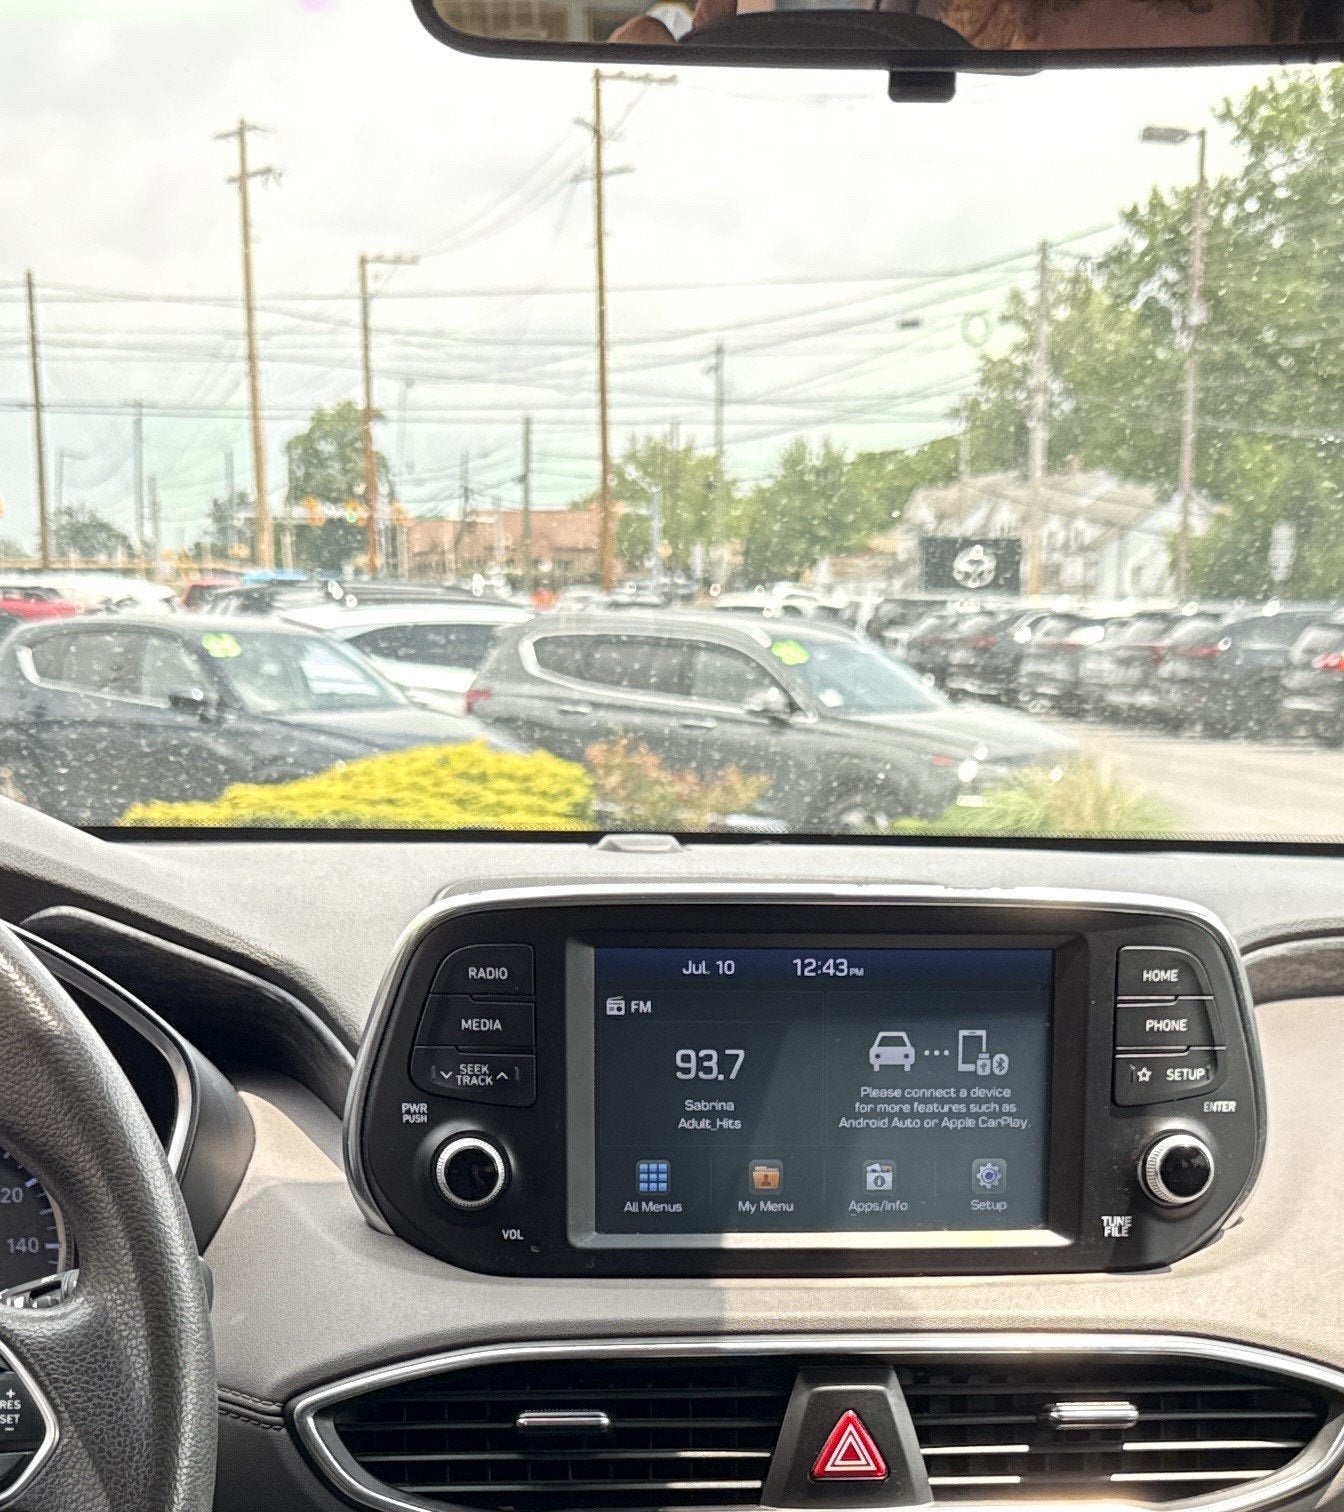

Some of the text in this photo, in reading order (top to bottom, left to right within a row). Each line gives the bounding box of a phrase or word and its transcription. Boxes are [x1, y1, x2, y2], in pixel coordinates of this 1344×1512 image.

[468, 967, 509, 980] RADIO
[716, 960, 736, 975] 10
[1143, 969, 1179, 982] HOME
[630, 1000, 652, 1014] FM
[461, 1019, 503, 1031] MEDIA
[1145, 1018, 1188, 1032] PHONE
[459, 1063, 490, 1075] SEEK
[675, 1049, 746, 1081] 93.7
[456, 1075, 494, 1086] TRACK
[1165, 1068, 1206, 1081] SETUP
[860, 1086, 1012, 1098] Please connect a device
[401, 1103, 429, 1114] PWR
[684, 1099, 735, 1112] Sabrina
[855, 1101, 1017, 1113] for more features such as
[1203, 1101, 1237, 1113] ENTER
[402, 1114, 428, 1123] PUSH
[678, 1117, 743, 1131] Adult_Hits
[839, 1117, 889, 1128] Android
[891, 1117, 920, 1128] Auto
[923, 1119, 939, 1128] or
[941, 1117, 976, 1130] Apple
[623, 1201, 683, 1213] All Menus
[738, 1201, 794, 1215] My Menu
[848, 1200, 909, 1214] Apps/Info
[971, 1199, 1008, 1214] Setup
[1100, 1215, 1133, 1227] TUNE
[501, 1229, 525, 1240] VOL
[1103, 1226, 1130, 1238] FILE
[7, 1237, 40, 1254] 140
[0, 1400, 21, 1410] RES
[0, 1414, 20, 1424] SET
